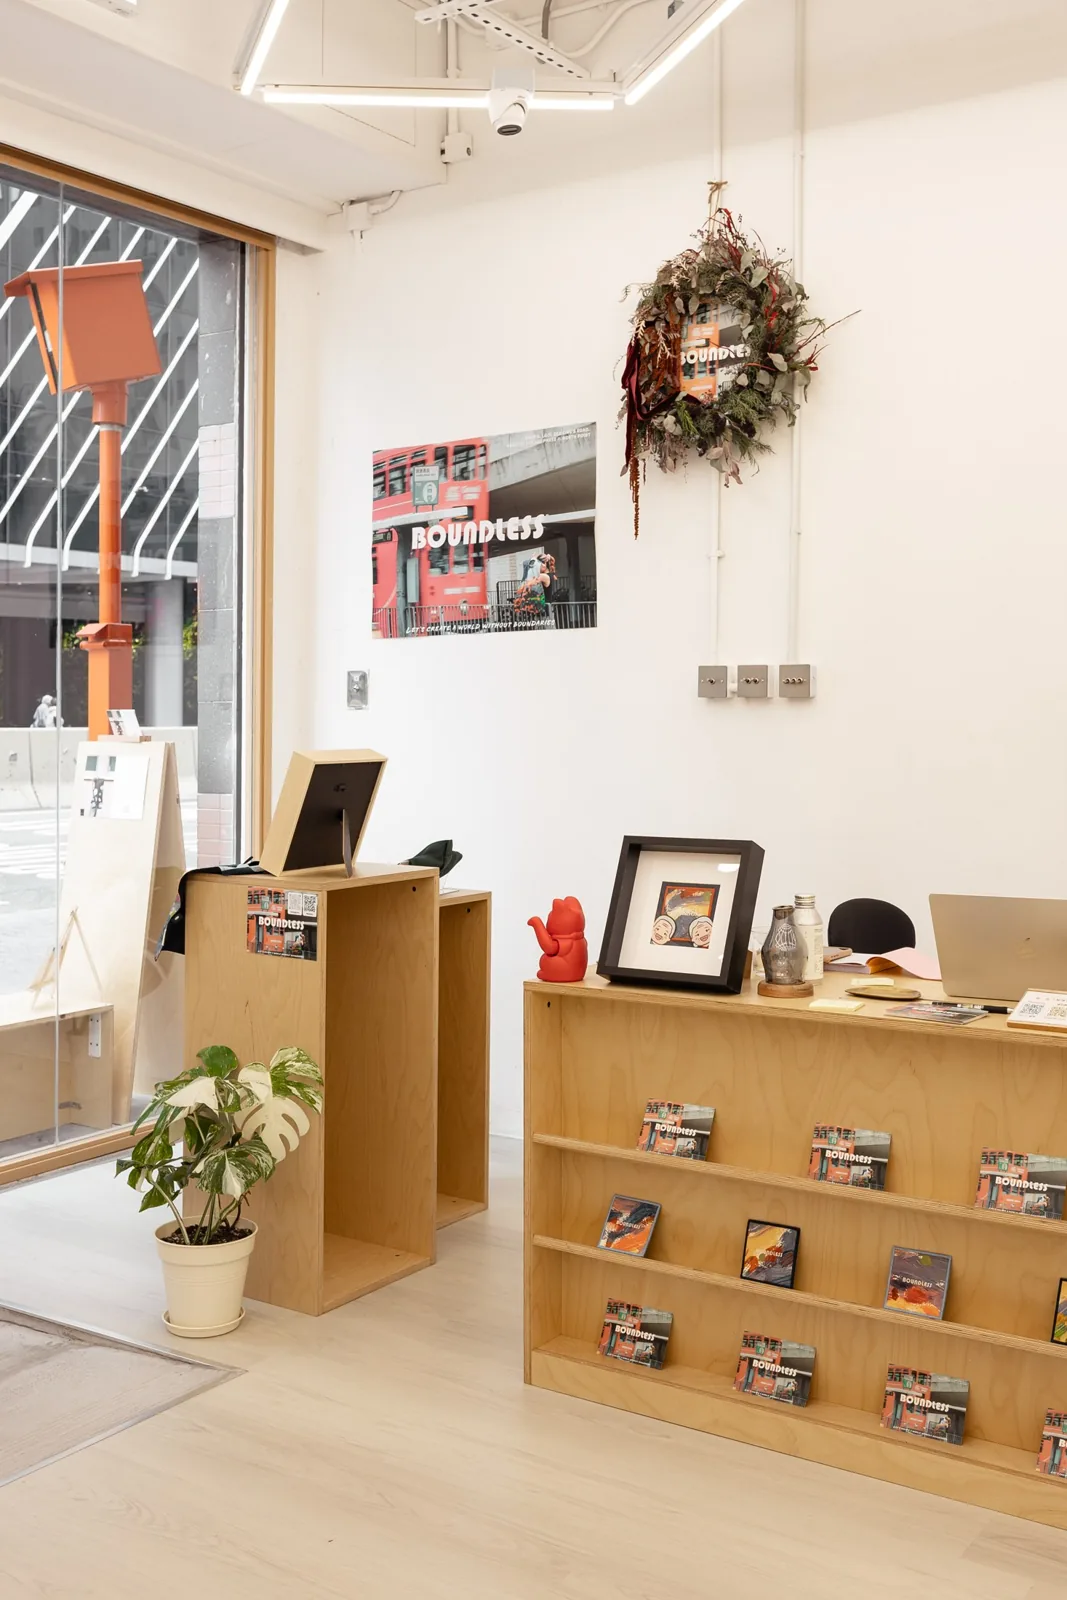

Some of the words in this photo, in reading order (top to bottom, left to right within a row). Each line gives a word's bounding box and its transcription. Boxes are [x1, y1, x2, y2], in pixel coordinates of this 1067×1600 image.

[411, 514, 545, 550] BOUNDLESS
[405, 626, 425, 634] LET'S
[426, 625, 451, 633] CREATE
[458, 623, 481, 631] WORLD
[482, 622, 512, 630] WITHOUT
[513, 619, 556, 628] BOUNDARIES
[258, 916, 305, 930] BOUNDLESS
[654, 1123, 698, 1137] BOUNDLESS
[825, 1149, 873, 1165] BOUNDLESS
[995, 1176, 1048, 1192] BOUNDLESS
[902, 1276, 933, 1288] BOUNDLESS
[614, 1324, 656, 1342] BOUNDLESS
[751, 1359, 798, 1377] BOUNDLESS
[899, 1393, 950, 1413] BOUNDLESS
